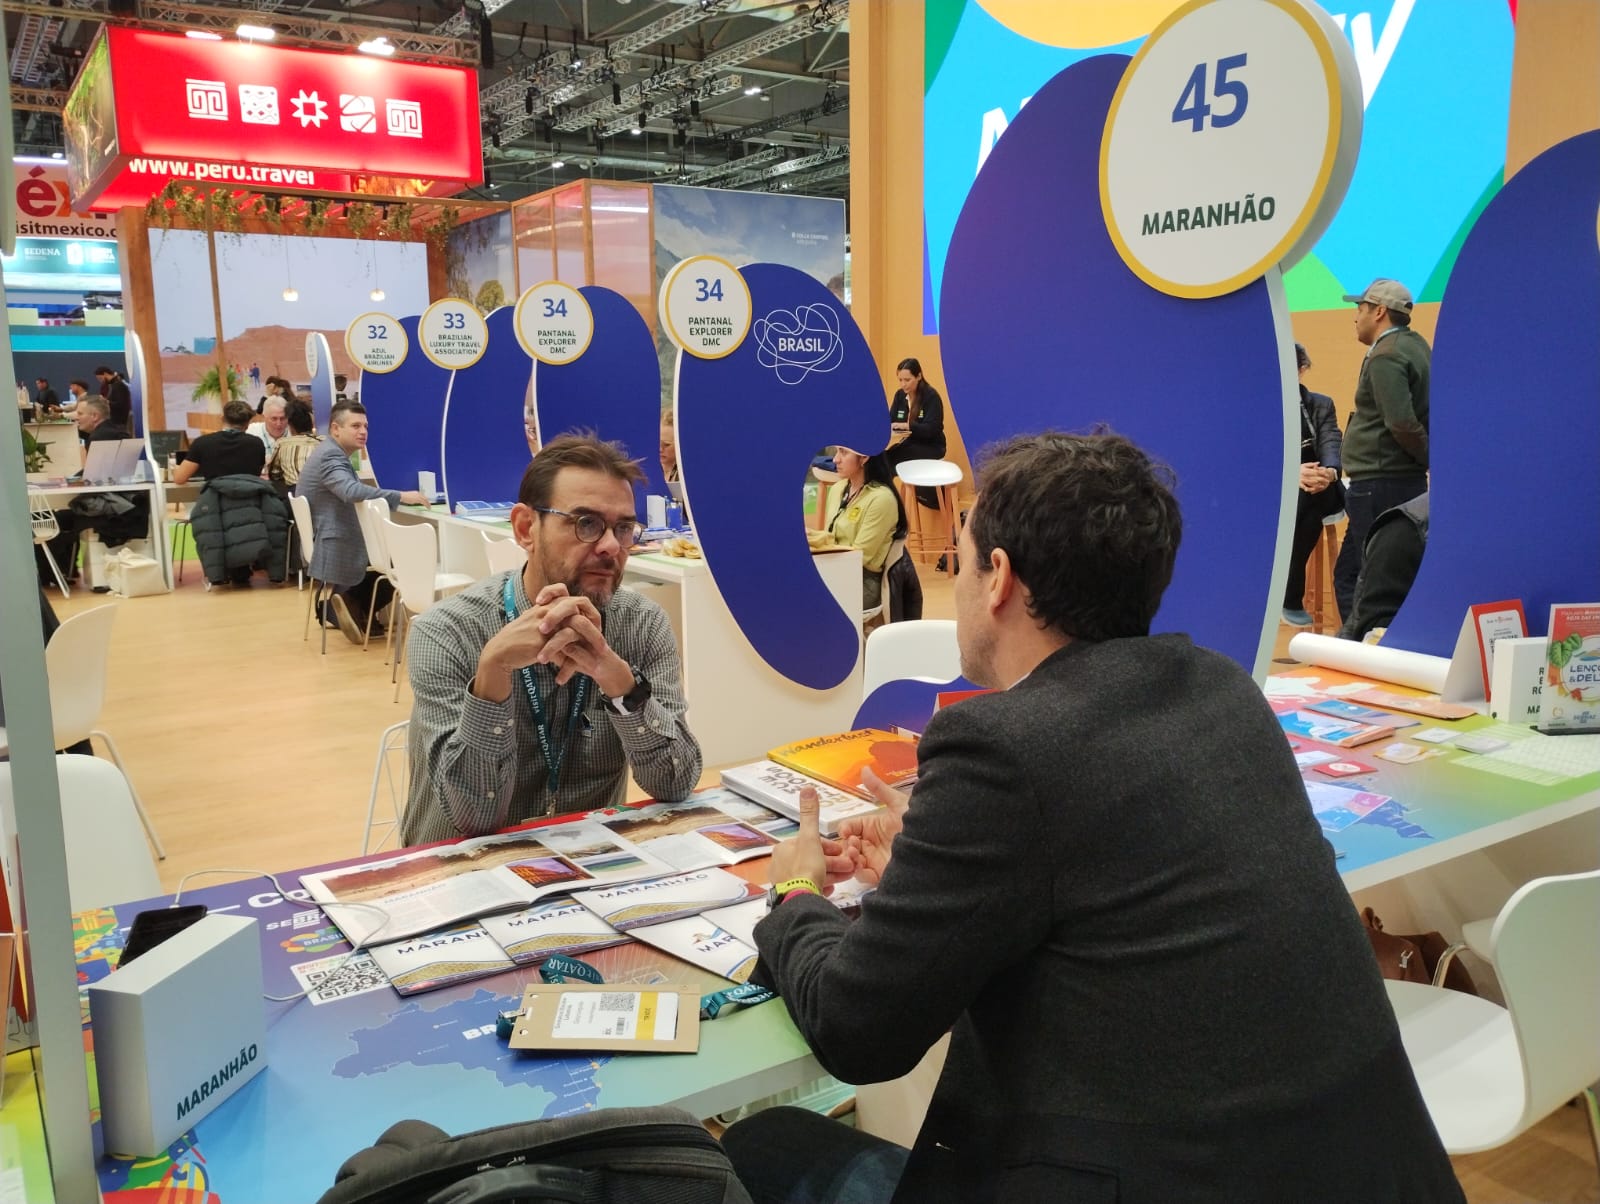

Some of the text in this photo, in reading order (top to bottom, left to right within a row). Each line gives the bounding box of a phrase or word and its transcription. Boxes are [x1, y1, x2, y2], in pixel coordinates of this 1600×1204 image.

[1171, 52, 1249, 134] 45
[129, 158, 315, 185] www.peru.travel
[1141, 193, 1276, 236] MARANHÃO
[695, 278, 724, 302] 34
[543, 298, 568, 318] 34
[443, 313, 465, 329] 33
[688, 317, 733, 326] PANTANAL
[367, 325, 388, 339] 32
[689, 327, 733, 336] EXPLORER
[538, 338, 577, 346] EXPLORER
[702, 338, 721, 346] DMC
[778, 337, 825, 352] BRASIL
[598, 873, 709, 899] MARANHÃO
[176, 1043, 258, 1121] MARANHÃO
